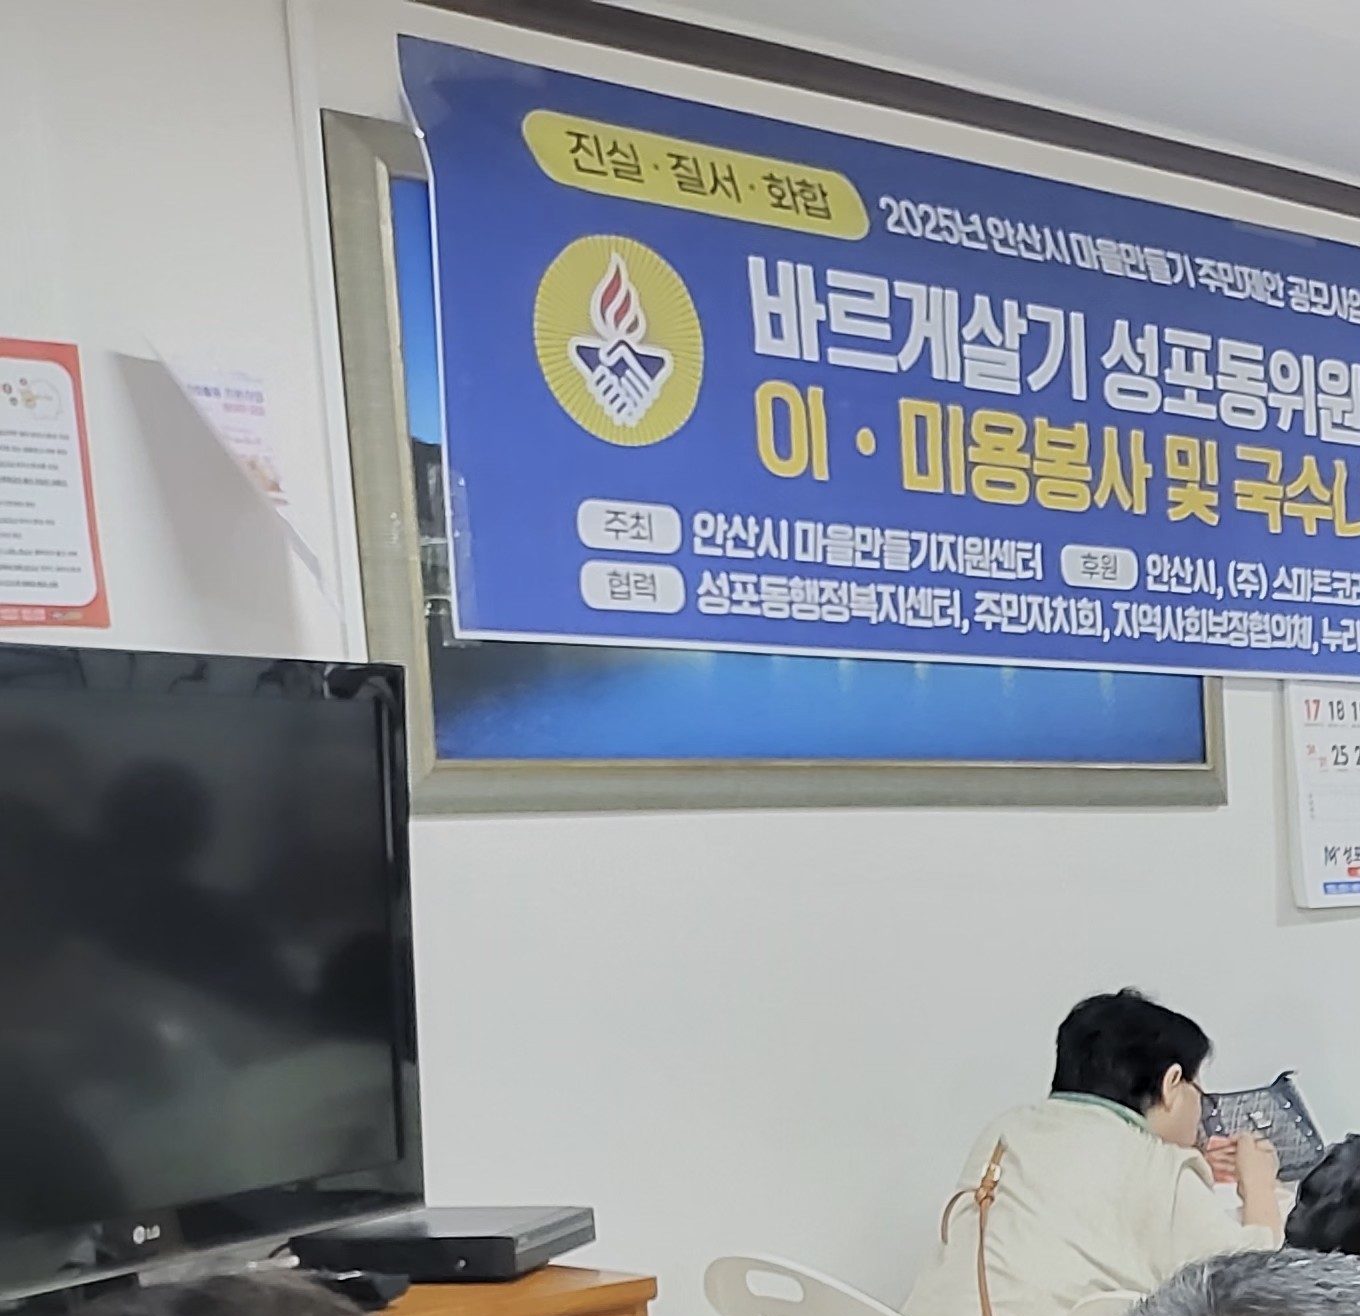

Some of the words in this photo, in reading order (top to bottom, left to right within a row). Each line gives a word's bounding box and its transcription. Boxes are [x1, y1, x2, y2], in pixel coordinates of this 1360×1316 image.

[879, 196, 988, 251] 2025년
[988, 216, 1071, 265] 안산시
[1069, 232, 1196, 288] 마을만들기
[1195, 256, 1285, 308] 주민제안
[747, 254, 1088, 402] 바르게살기
[1163, 432, 1221, 523] 및
[604, 510, 654, 543] 주최
[692, 510, 789, 562] 안산시
[794, 519, 1044, 581] 마을만들기지원센터
[1079, 551, 1119, 580] 후원
[1146, 552, 1224, 601] 안산시,
[1226, 559, 1268, 601] (주)
[607, 570, 658, 603] 협력
[697, 569, 970, 634] 성포동행정복지센터,
[973, 588, 1110, 643] 주민자치회,
[1112, 600, 1319, 656] 지역사회보장협의체,
[1304, 699, 1320, 721] 17
[1329, 700, 1345, 721] 18
[1331, 744, 1349, 766] 25
